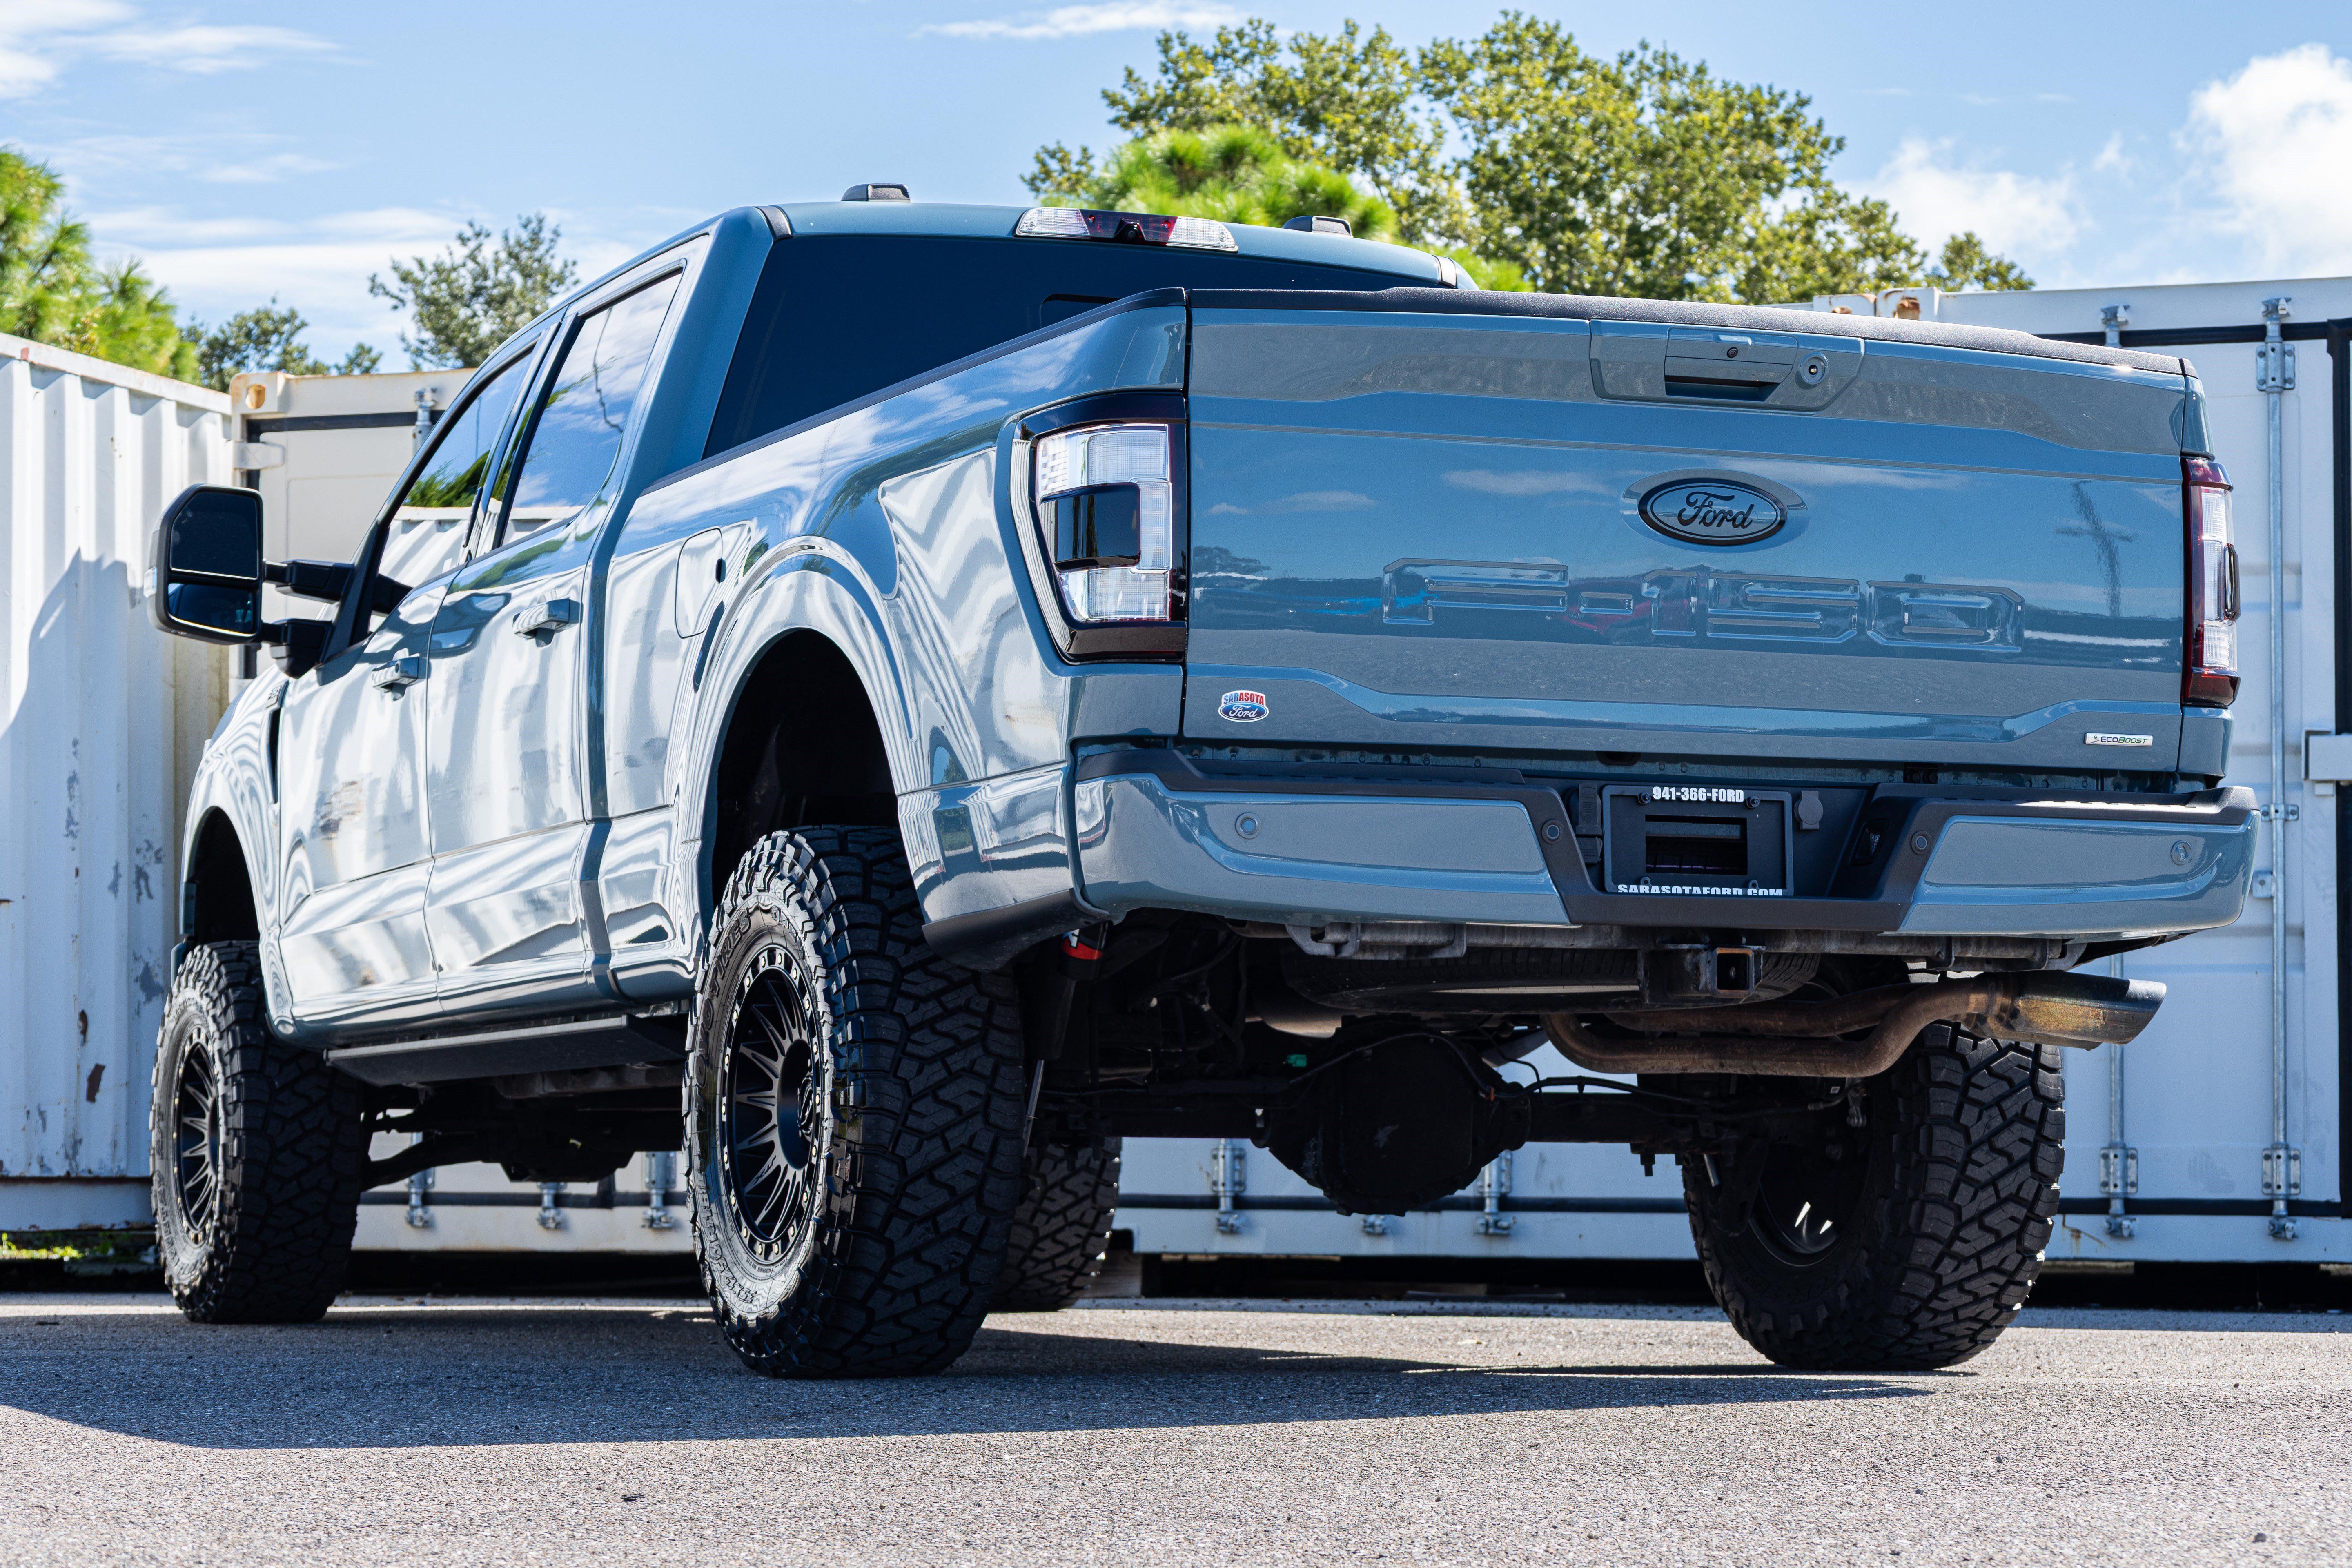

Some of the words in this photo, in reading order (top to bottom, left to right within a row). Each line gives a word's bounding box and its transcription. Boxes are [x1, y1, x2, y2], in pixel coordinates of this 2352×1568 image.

[1677, 491, 1755, 529] Ford
[1382, 557, 2025, 653] F-150
[1223, 692, 1264, 706] SARASOTA
[1229, 704, 1257, 717] Ford
[2100, 736, 2148, 744] ECOBOOST
[1653, 786, 1744, 802] 941-366-FORD
[1617, 884, 1783, 896] SARASOTAFORDCOM
[694, 998, 714, 1111] TOYO
[708, 907, 751, 999] TIRES
